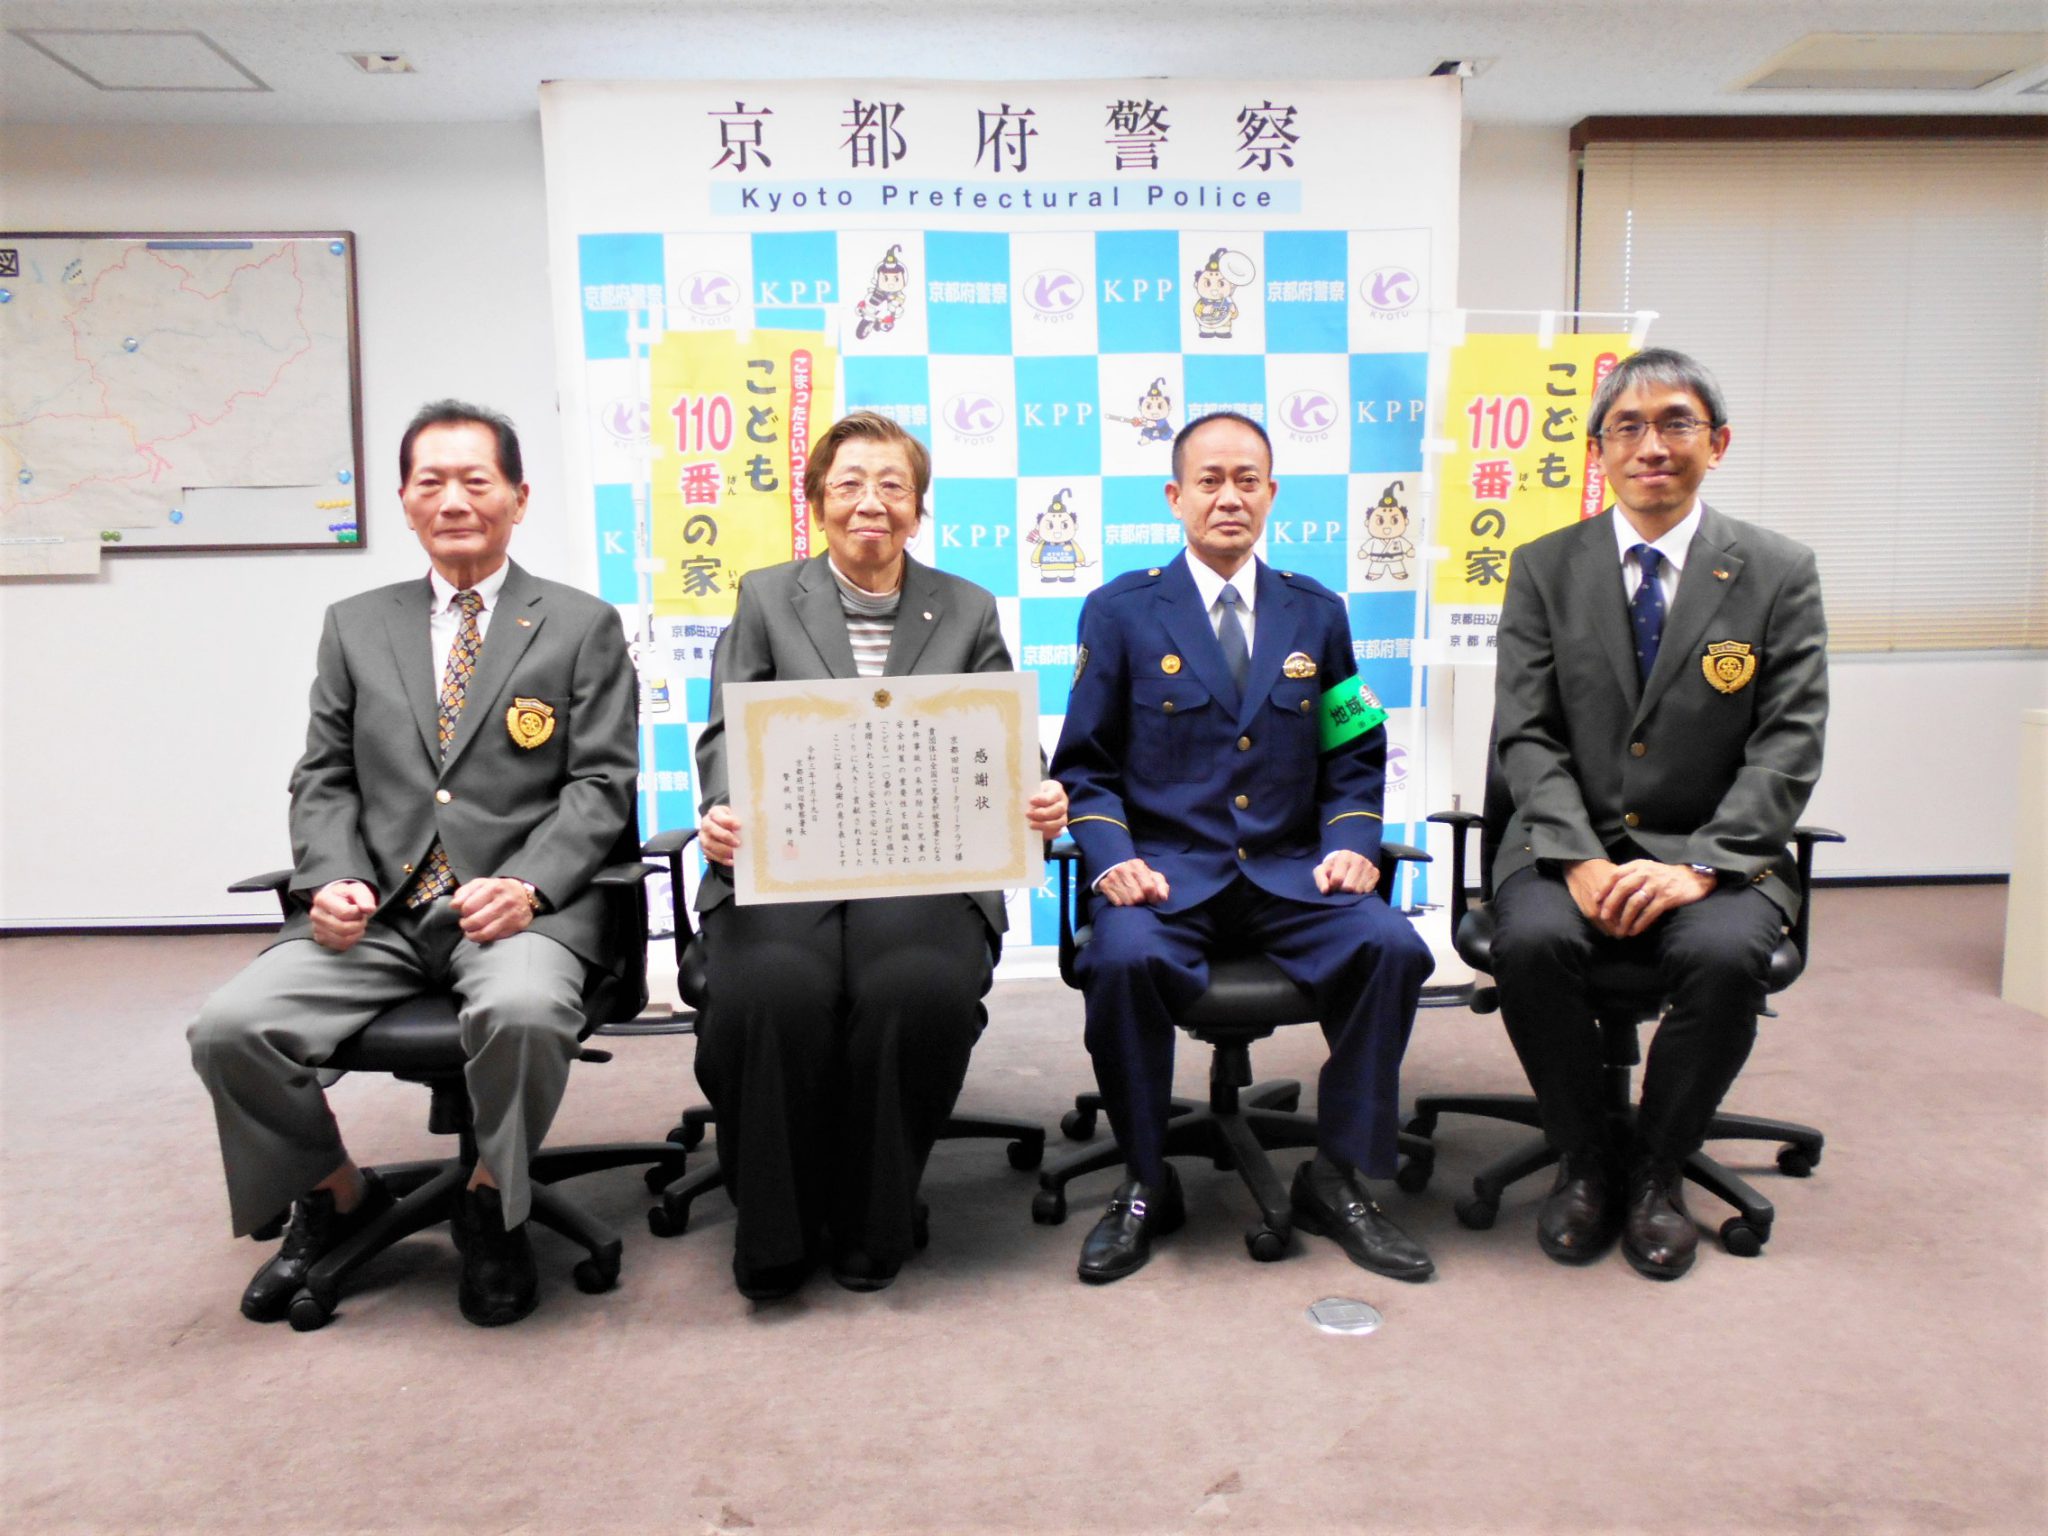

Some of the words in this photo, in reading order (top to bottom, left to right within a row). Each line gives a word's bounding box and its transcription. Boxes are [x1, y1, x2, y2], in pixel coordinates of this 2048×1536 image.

[707, 98, 1300, 172] 京都府警察
[741, 186, 853, 212] Kyoto
[882, 185, 1119, 209] Prefectural
[1148, 185, 1272, 208] Police
[760, 280, 832, 304] KPP
[928, 281, 1008, 304] 京都府警察
[1103, 279, 1174, 303] KPP
[1267, 280, 1345, 303] 京都府警察
[1033, 311, 1075, 324] KYOTO
[1024, 403, 1094, 427] KPP
[1357, 399, 1425, 424] KPP
[745, 360, 778, 492] こども
[1537, 362, 1578, 489] こども
[953, 434, 995, 447] KYOTO
[1289, 432, 1329, 443] KYOTO
[941, 525, 1011, 548] KPP
[1104, 523, 1181, 544] 京都府警察
[1274, 521, 1341, 544] KPP
[1353, 638, 1411, 660] 京都府警
[975, 747, 991, 810] 感謝状
